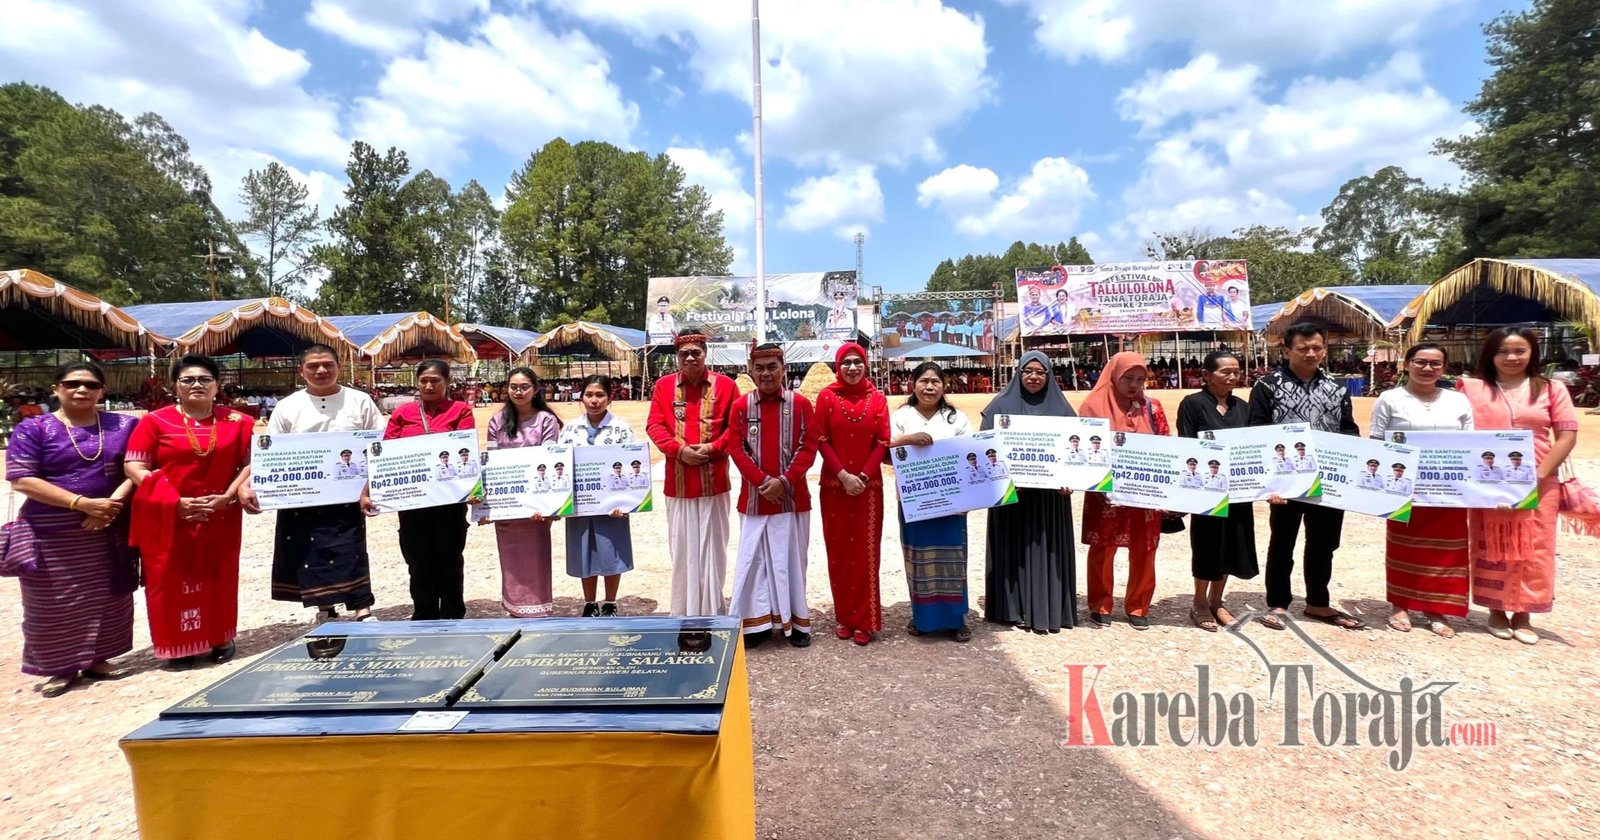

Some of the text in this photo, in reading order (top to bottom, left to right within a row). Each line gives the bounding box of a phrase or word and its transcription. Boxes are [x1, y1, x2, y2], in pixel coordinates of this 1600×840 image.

[1110, 273, 1152, 283] FESTIVAL
[1087, 279, 1176, 298] TALLULOLONA
[686, 309, 815, 321] Festival Talu Lolona
[724, 323, 778, 332] Tana Toaja
[1007, 452, 1061, 463] 42.000.000,-
[1324, 450, 1358, 459] SANTUNAN
[897, 454, 959, 469] PENYERAHAN SANTUNAN
[910, 464, 940, 472] MENINGGAL
[1126, 465, 1162, 473] MUHAMMAD
[254, 472, 330, 484] Rp42.000.000,-
[371, 474, 432, 490] Rp42.000.000,-
[901, 476, 962, 494] Rp82.000.000,-
[361, 659, 474, 670] MARANDANG
[500, 656, 715, 668] JEMBATAN S. SALAKKA
